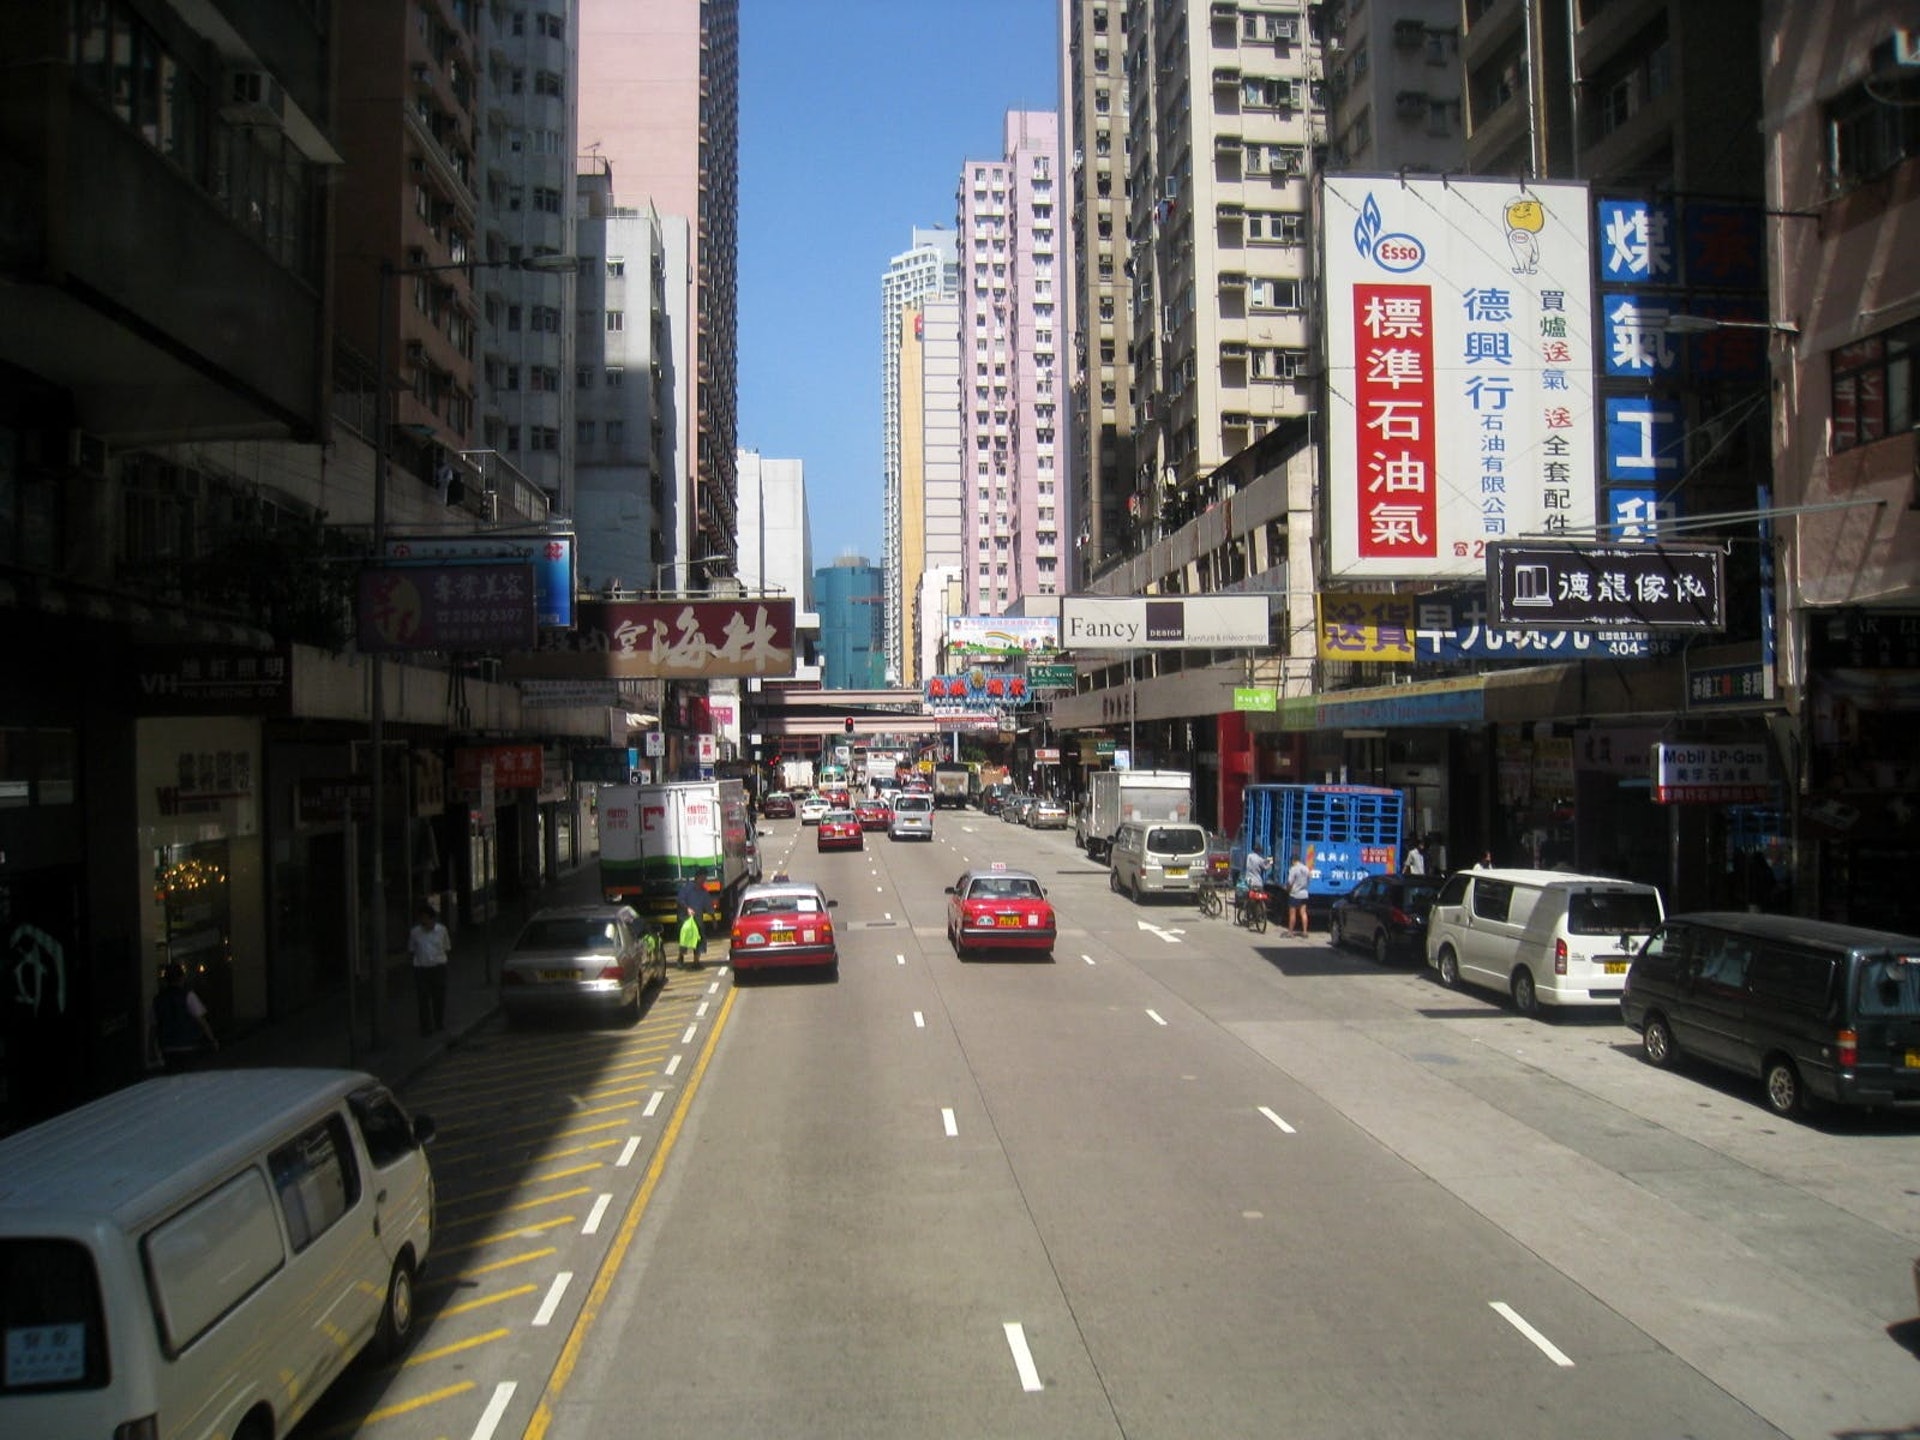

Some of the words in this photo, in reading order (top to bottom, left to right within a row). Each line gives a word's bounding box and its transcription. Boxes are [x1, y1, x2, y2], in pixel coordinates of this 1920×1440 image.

[1381, 242, 1418, 259] Esso
[1363, 295, 1429, 546] 標準石油氣
[1558, 572, 1706, 603] 德龍傢俬
[1071, 617, 1139, 641] Fancy
[1325, 602, 1415, 652] 送貨
[1664, 749, 1706, 764] Mobil
